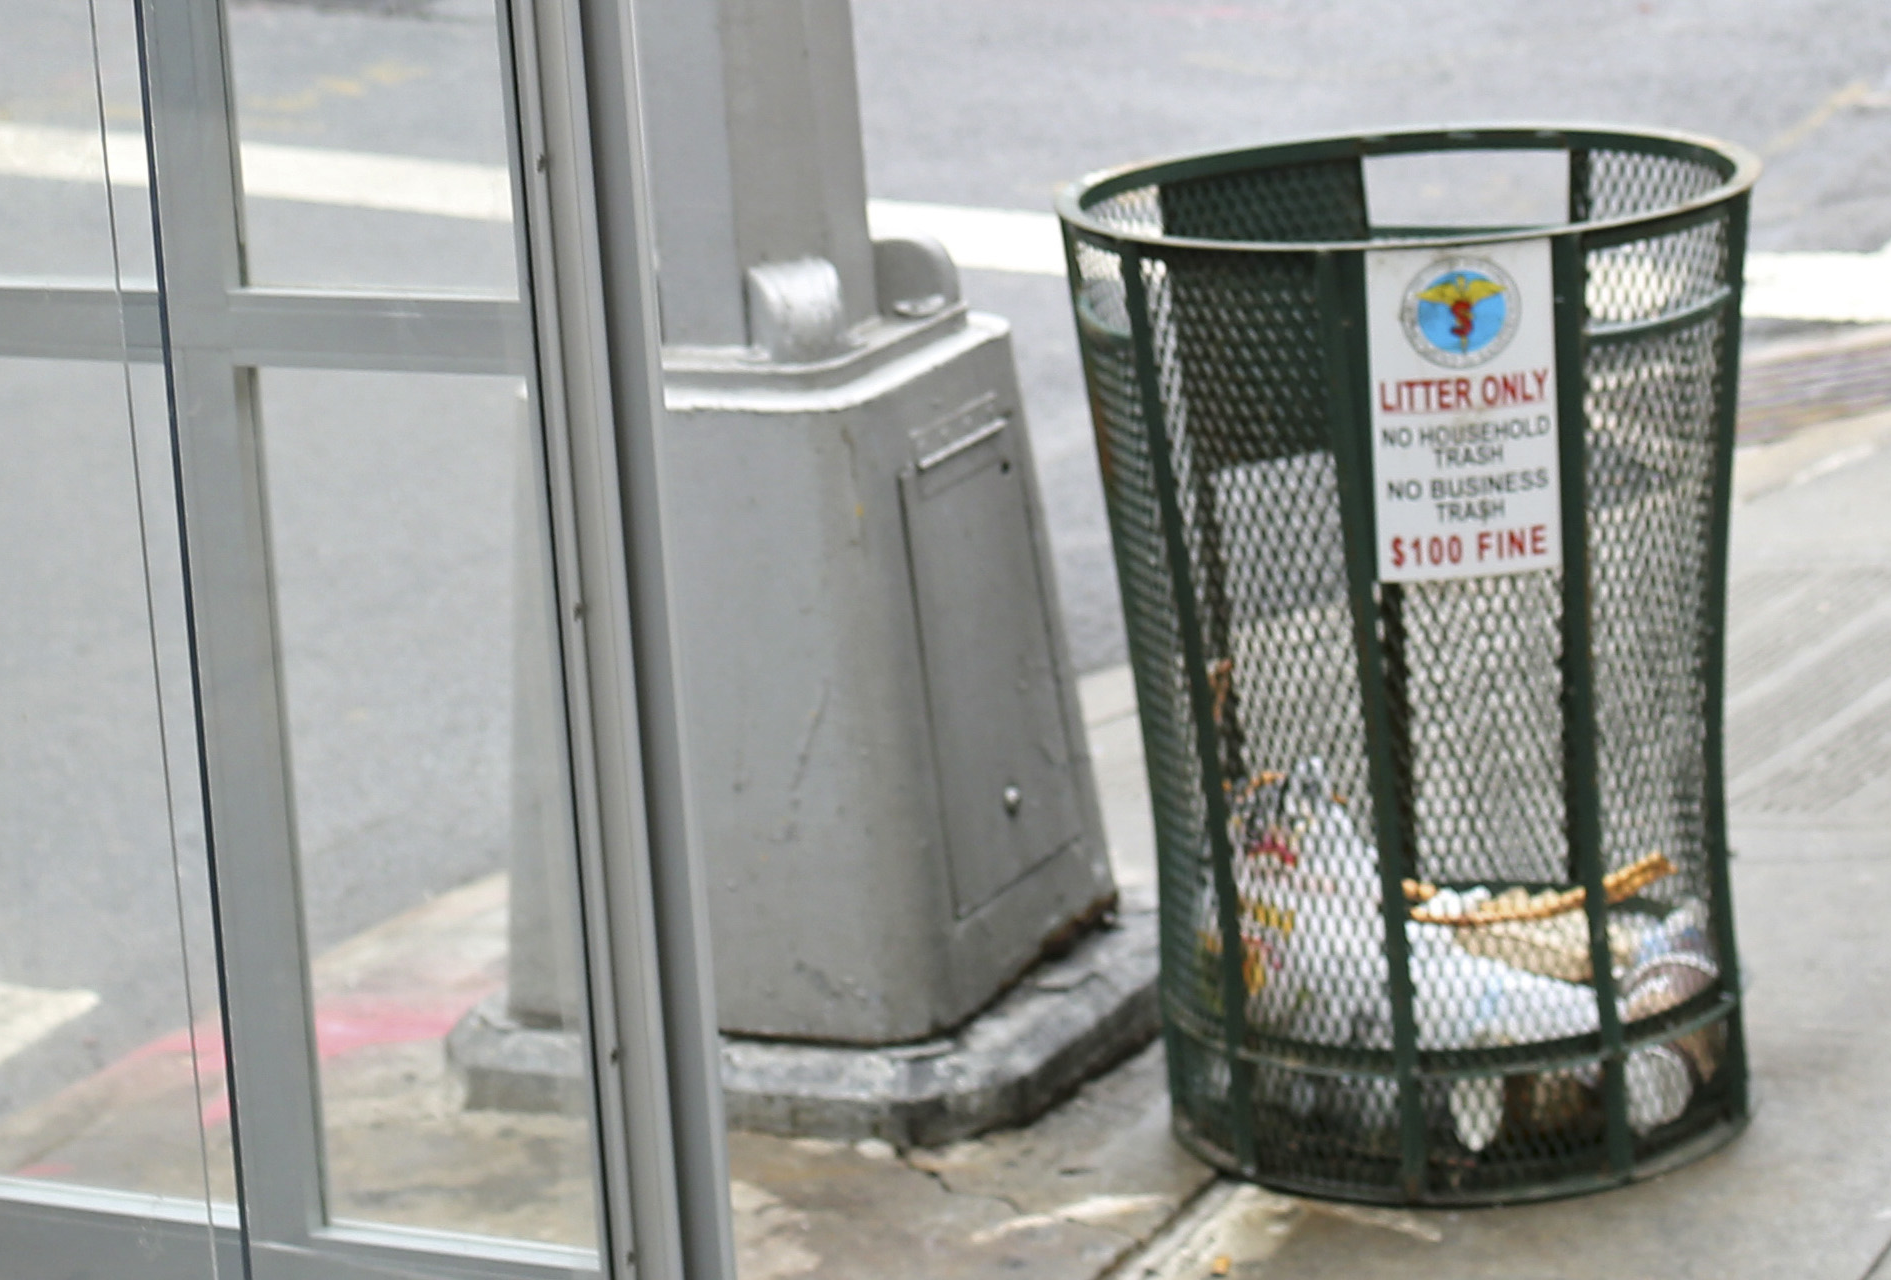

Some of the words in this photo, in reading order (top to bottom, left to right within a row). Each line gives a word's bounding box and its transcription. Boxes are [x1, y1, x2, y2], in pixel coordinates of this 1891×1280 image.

[1380, 377, 1472, 412] LITTER
[1481, 368, 1548, 406] ONLY
[1382, 426, 1412, 447] NO
[1420, 415, 1551, 447] HOUSEHOLD
[1434, 445, 1504, 468] TRASH
[1387, 479, 1422, 501] NO
[1430, 467, 1549, 499] BUSINESS
[1436, 500, 1505, 523] TRASH
[1391, 534, 1463, 567] $100
[1477, 524, 1547, 561] FINE
